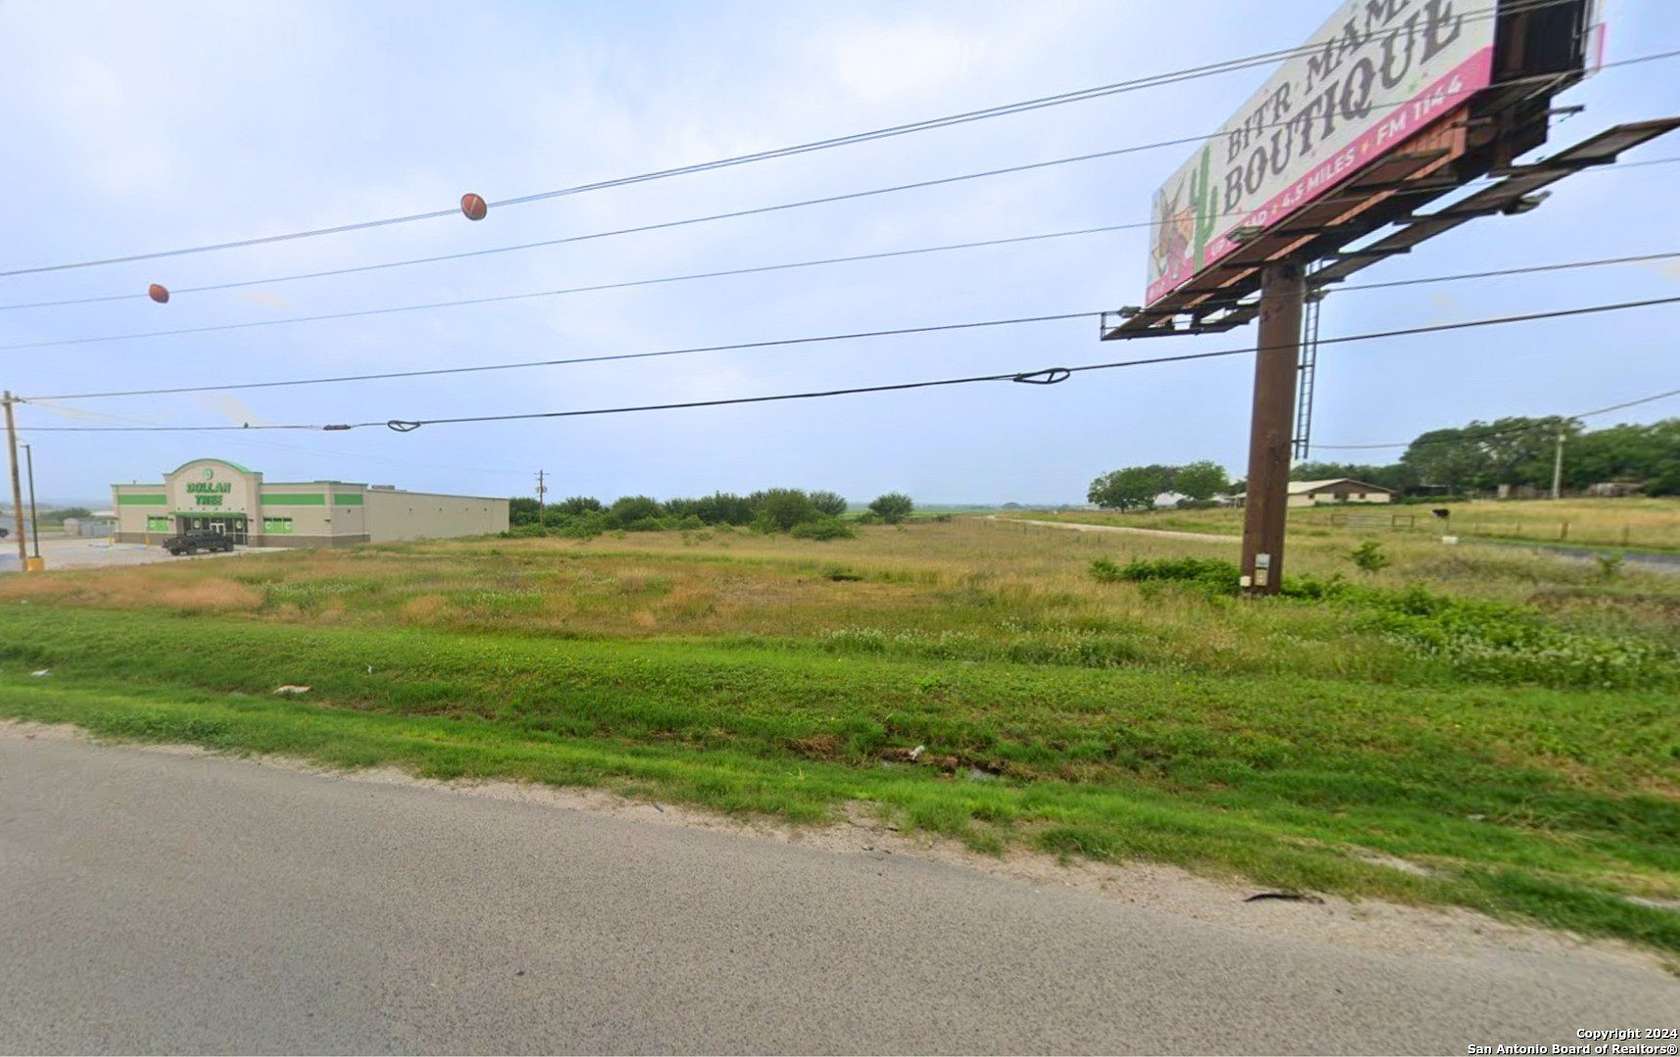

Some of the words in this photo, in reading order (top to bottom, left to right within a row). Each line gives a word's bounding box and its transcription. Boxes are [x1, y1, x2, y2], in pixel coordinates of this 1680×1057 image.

[1304, 0, 1411, 95] MAM
[1224, 0, 1461, 216] BOUTIQUE
[1281, 185, 1305, 208] 4.5
[1306, 148, 1356, 192] MILES
[1377, 112, 1407, 145] FM
[186, 481, 231, 494] DOLLAR
[195, 495, 223, 506] TREE
